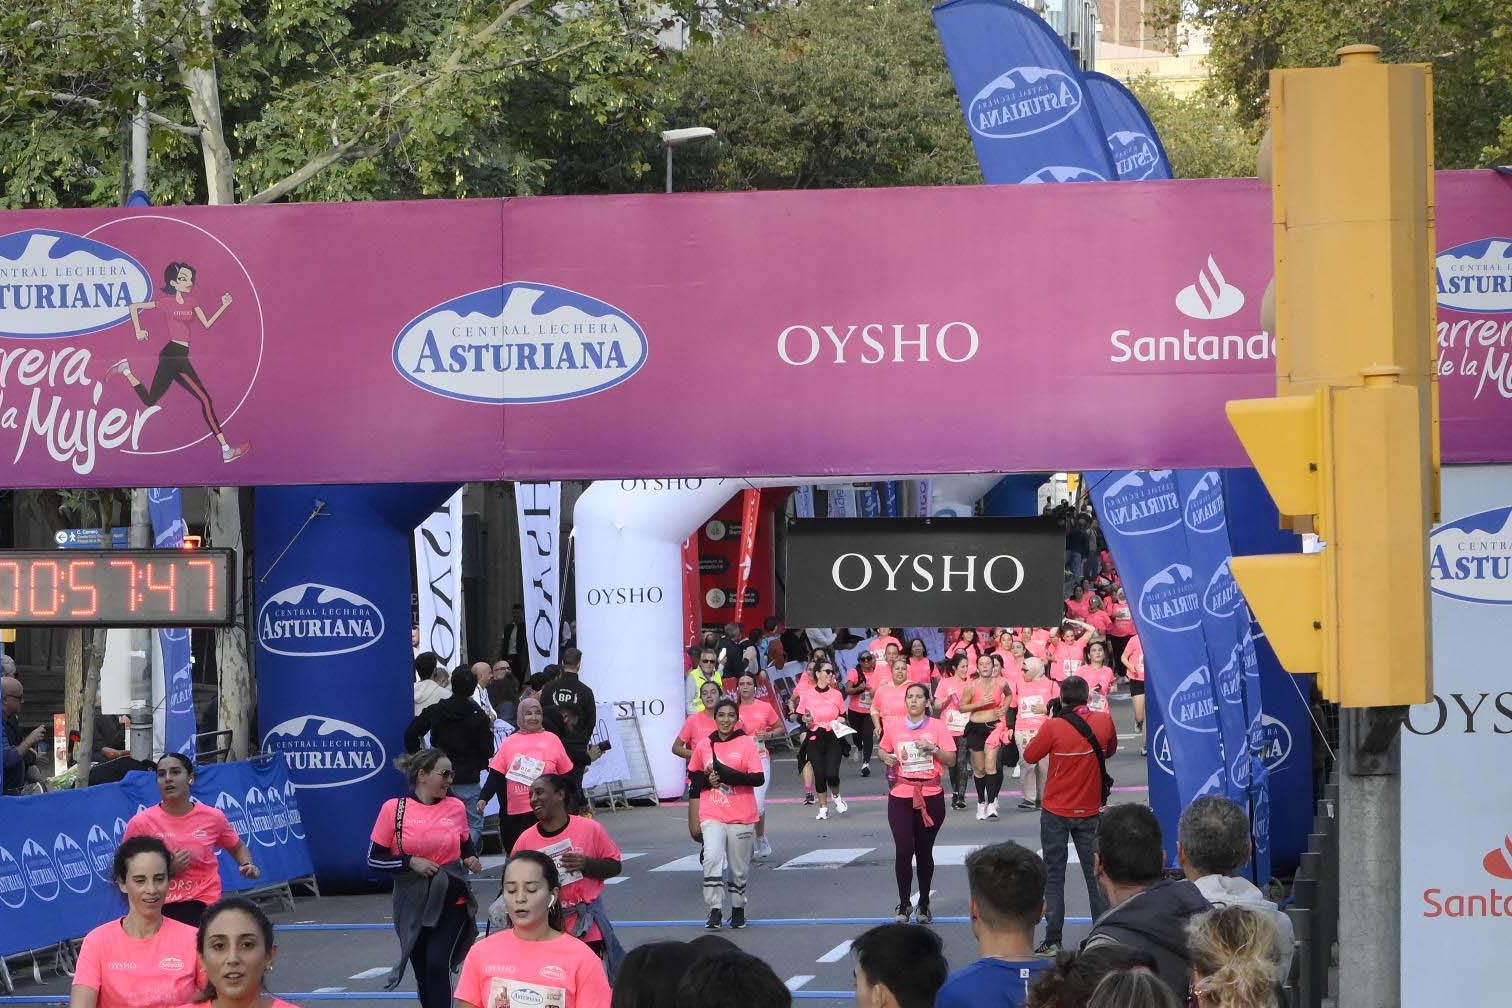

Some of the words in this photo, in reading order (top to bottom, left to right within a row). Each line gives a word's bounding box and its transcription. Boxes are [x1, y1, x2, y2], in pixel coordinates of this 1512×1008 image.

[56, 265, 127, 277] LECHERA
[452, 325, 530, 338] CENTRAL
[539, 323, 618, 336] LECHERA
[777, 321, 979, 366] OYSHO
[413, 329, 628, 374] ASTURIANA
[1111, 329, 1276, 362] Santand
[1460, 349, 1477, 376] la
[14, 380, 161, 475] Mujer
[831, 552, 1025, 594] OYSHO
[587, 586, 663, 606] OYSHO
[275, 608, 317, 617] CENTRAL
[322, 608, 370, 616] LECHERA
[262, 612, 376, 640] ASTURIANA
[617, 698, 665, 717] SHO
[268, 743, 377, 769] TURIANA
[276, 740, 318, 748] CENTRAL
[322, 739, 372, 748] LECHERA
